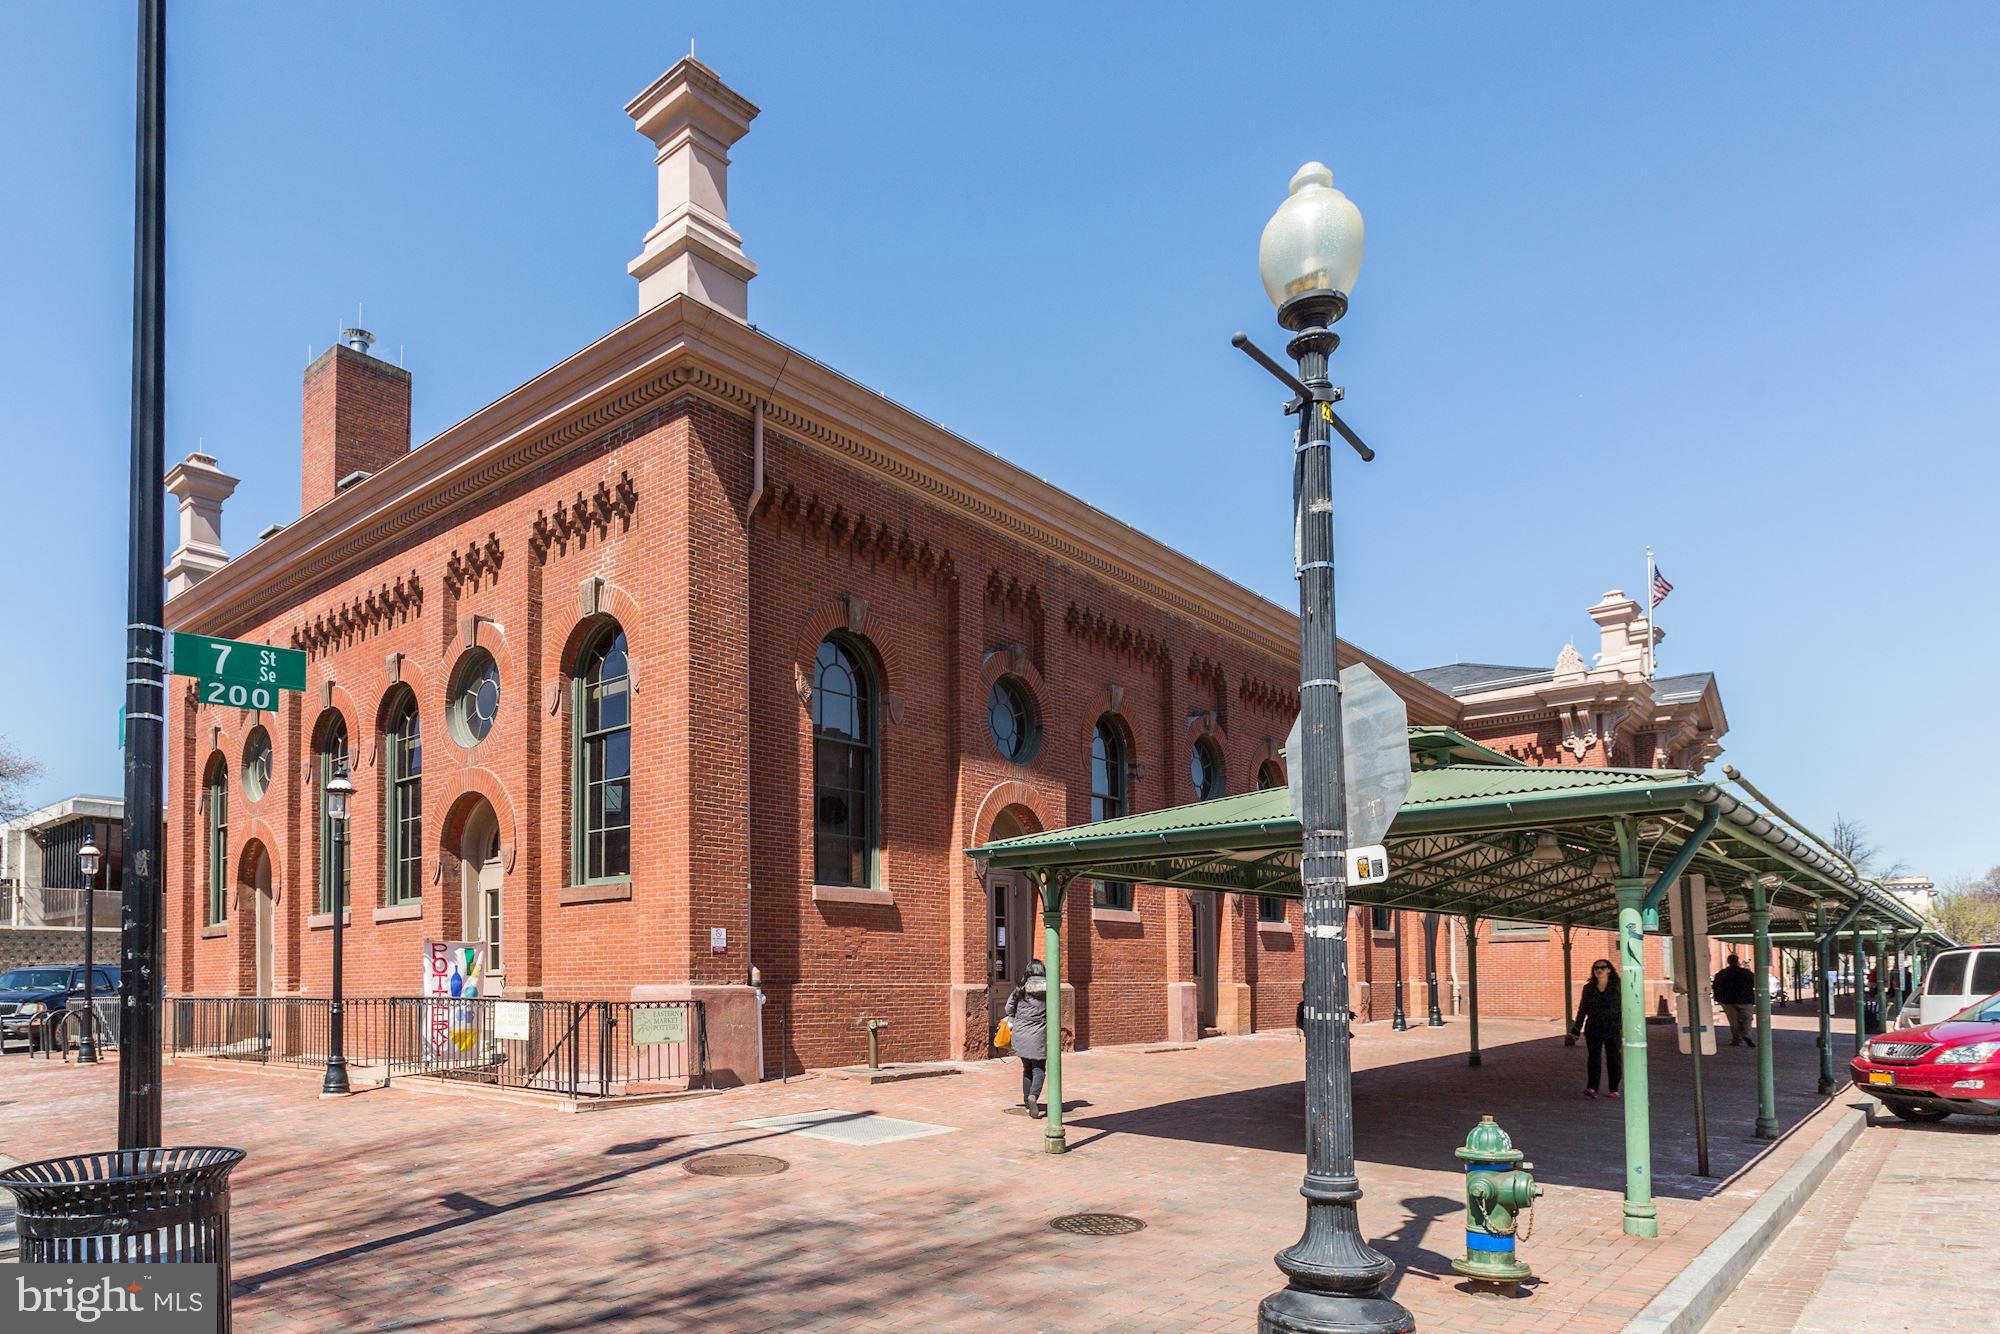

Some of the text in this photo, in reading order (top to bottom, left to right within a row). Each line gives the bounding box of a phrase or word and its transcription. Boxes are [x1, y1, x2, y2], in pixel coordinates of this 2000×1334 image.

[211, 644, 277, 675] 7 St
[260, 667, 277, 683] Se
[207, 682, 271, 709] 200
[432, 943, 448, 1056] POTTERY
